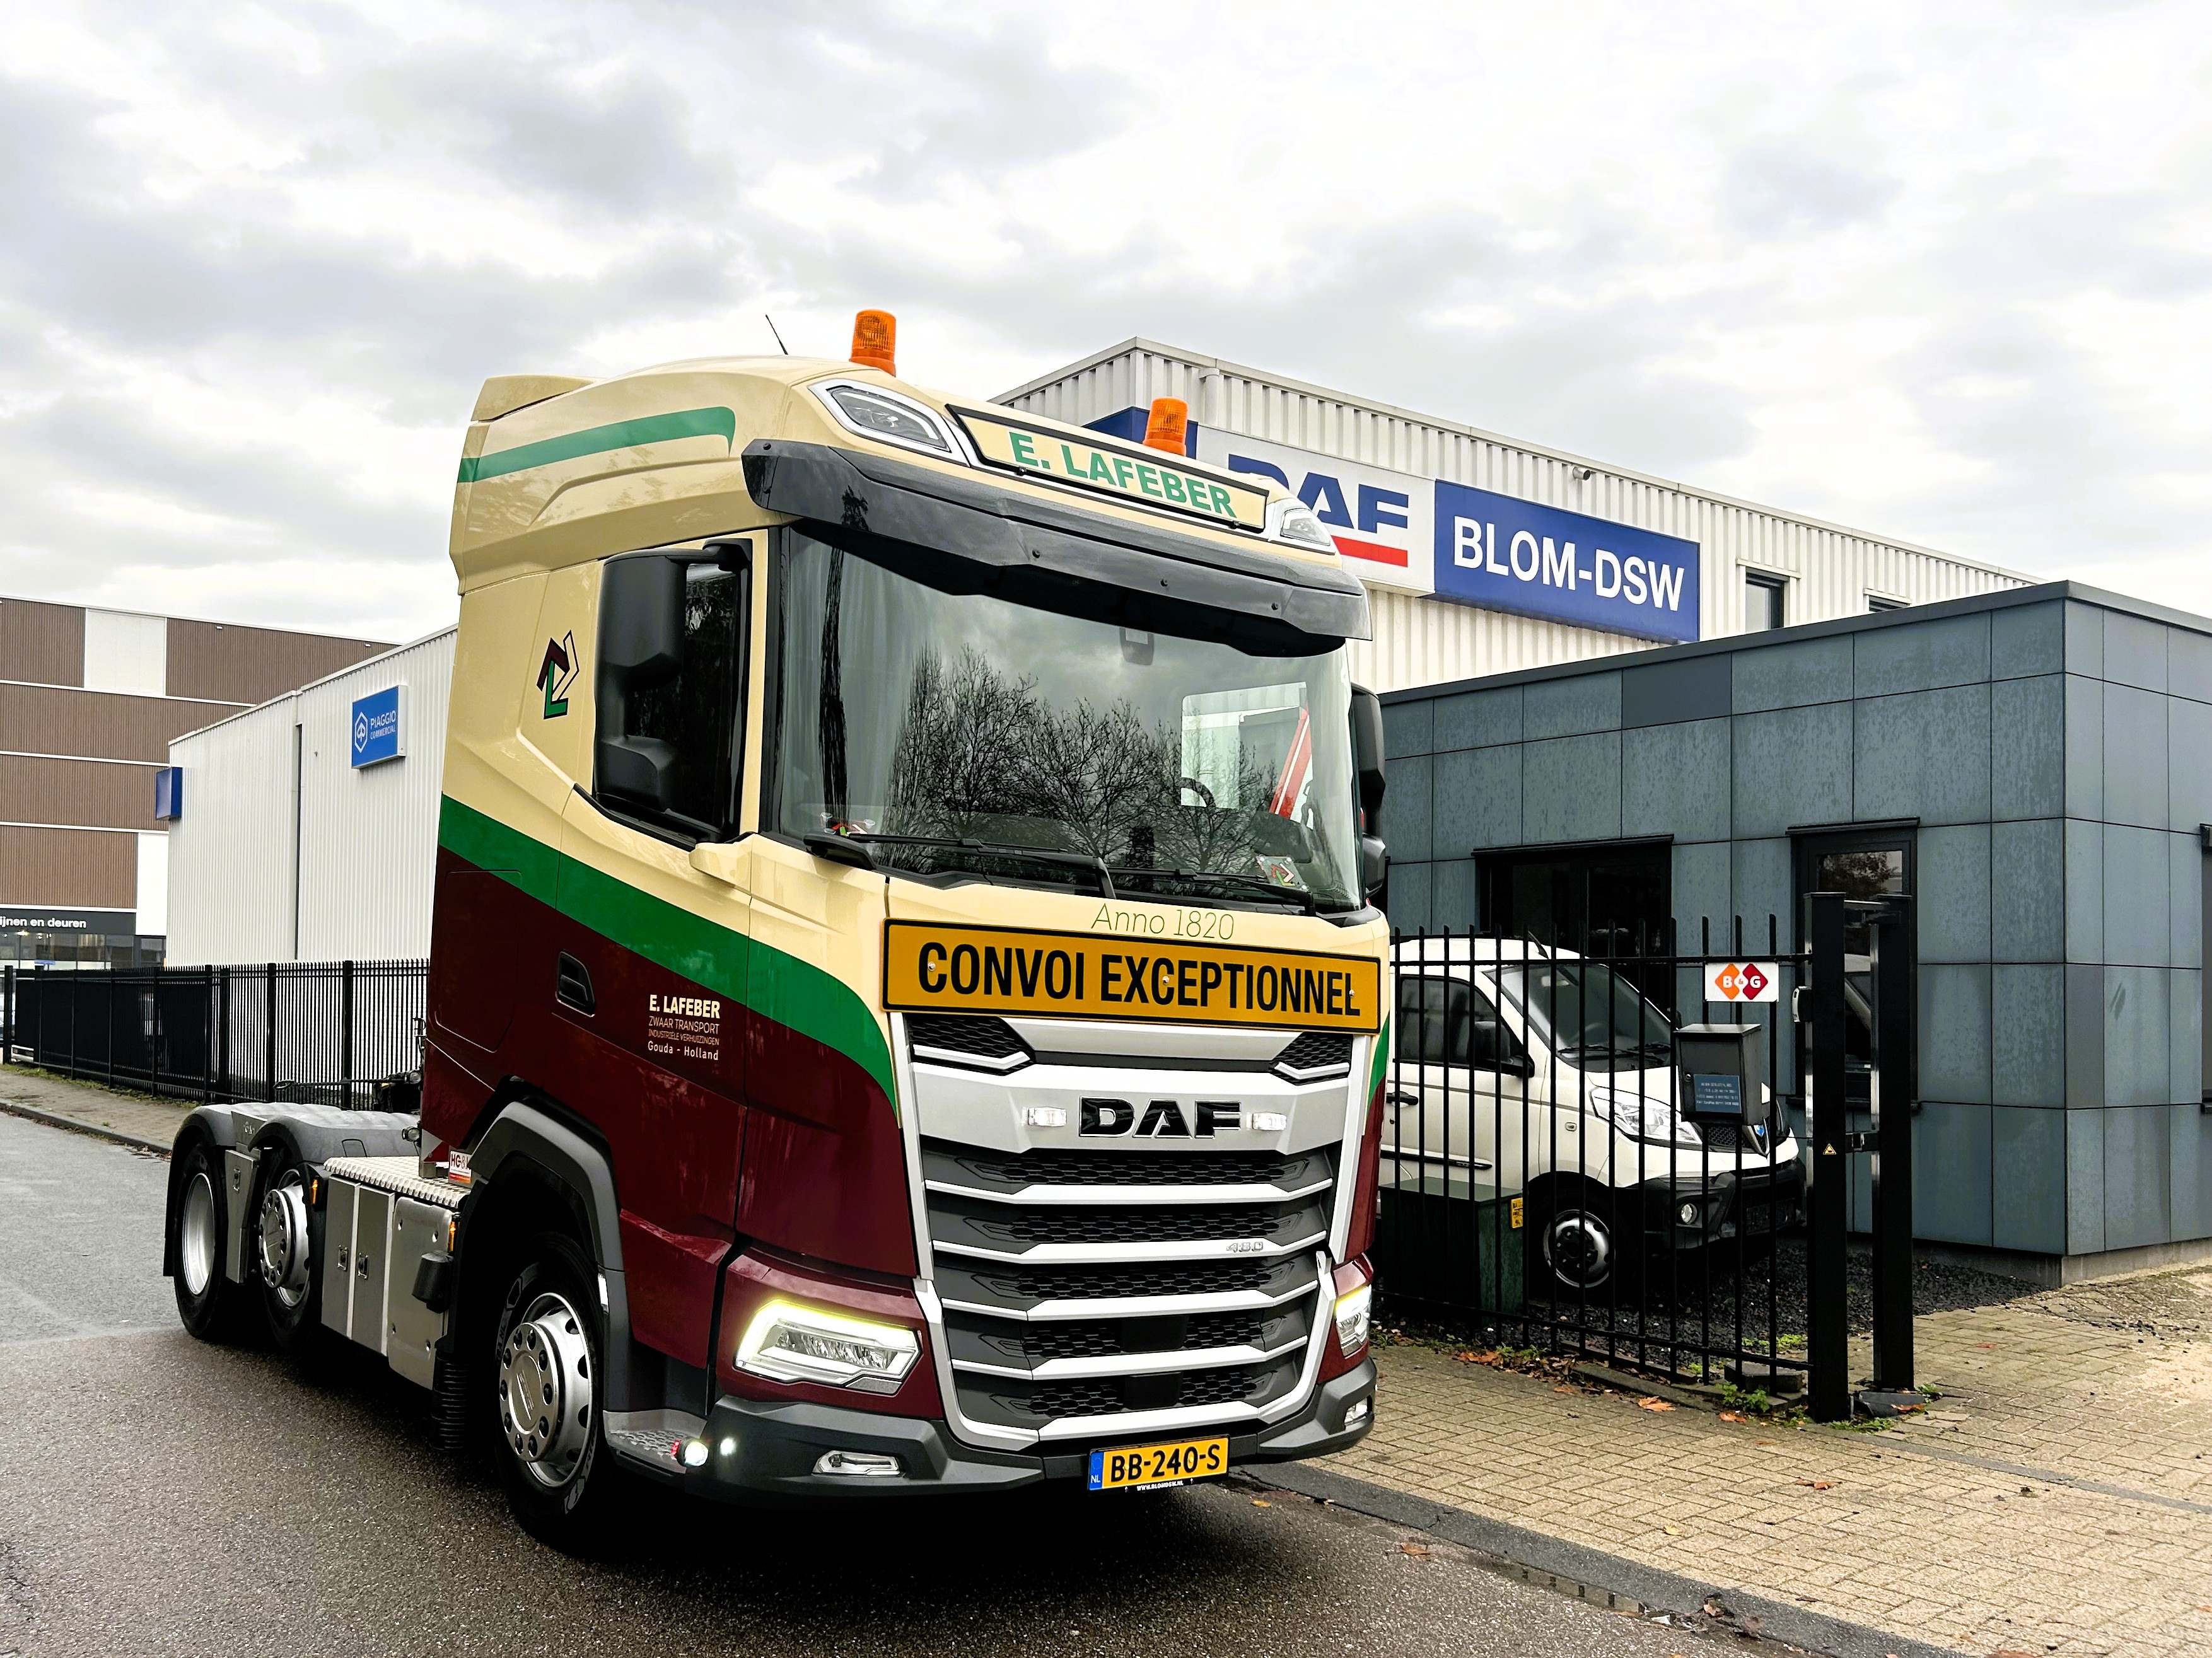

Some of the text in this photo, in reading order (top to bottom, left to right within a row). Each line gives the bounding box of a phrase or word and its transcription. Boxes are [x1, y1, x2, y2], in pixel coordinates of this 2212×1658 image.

[1009, 431, 1237, 519] E. LAFEBER
[1453, 516, 1685, 612] BLOM-DSW
[370, 710, 397, 730] PIAGGIO
[30, 919, 45, 927] en
[47, 917, 87, 928] deuren
[1090, 903, 1234, 941] Anno 1820
[918, 942, 1361, 1016] CONVOI EXCEPTIONNEL
[649, 994, 720, 1019] E. LAFEBER
[648, 1016, 720, 1035] ZWAAR TRANSPORT
[648, 1040, 673, 1054] Gouda
[684, 1045, 719, 1060] Holland
[1078, 1096, 1242, 1139] DAF
[1226, 1241, 1264, 1253] 480
[1090, 1444, 1221, 1483] NL BB-240-S
